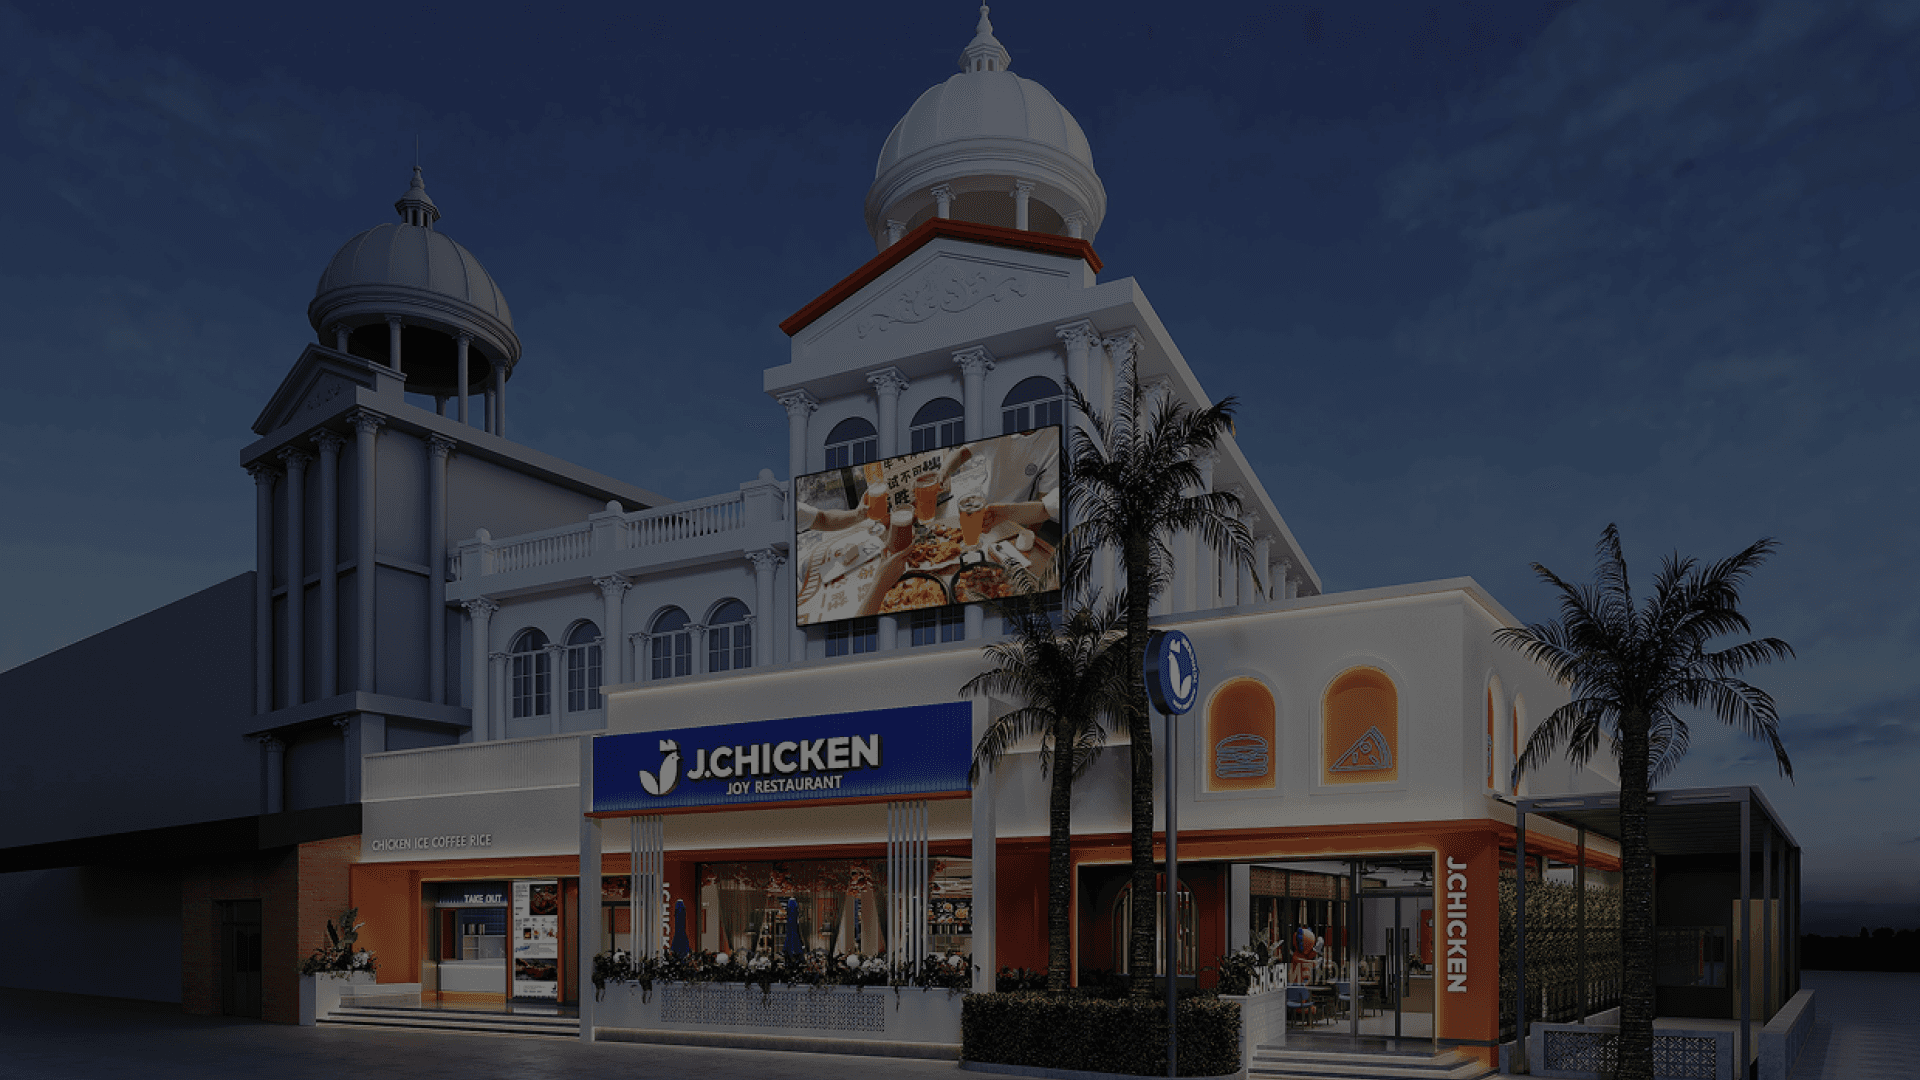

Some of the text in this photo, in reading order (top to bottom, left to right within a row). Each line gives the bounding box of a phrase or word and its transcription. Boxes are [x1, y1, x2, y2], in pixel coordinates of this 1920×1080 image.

[686, 732, 880, 780] J.CHICKEN
[726, 774, 843, 795] JOY RESTAURANT
[372, 834, 492, 851] CHICKEN ICE COFFEE RICE
[463, 894, 503, 904] TAKE OUT
[1446, 856, 1468, 993] J.CHICKEN
